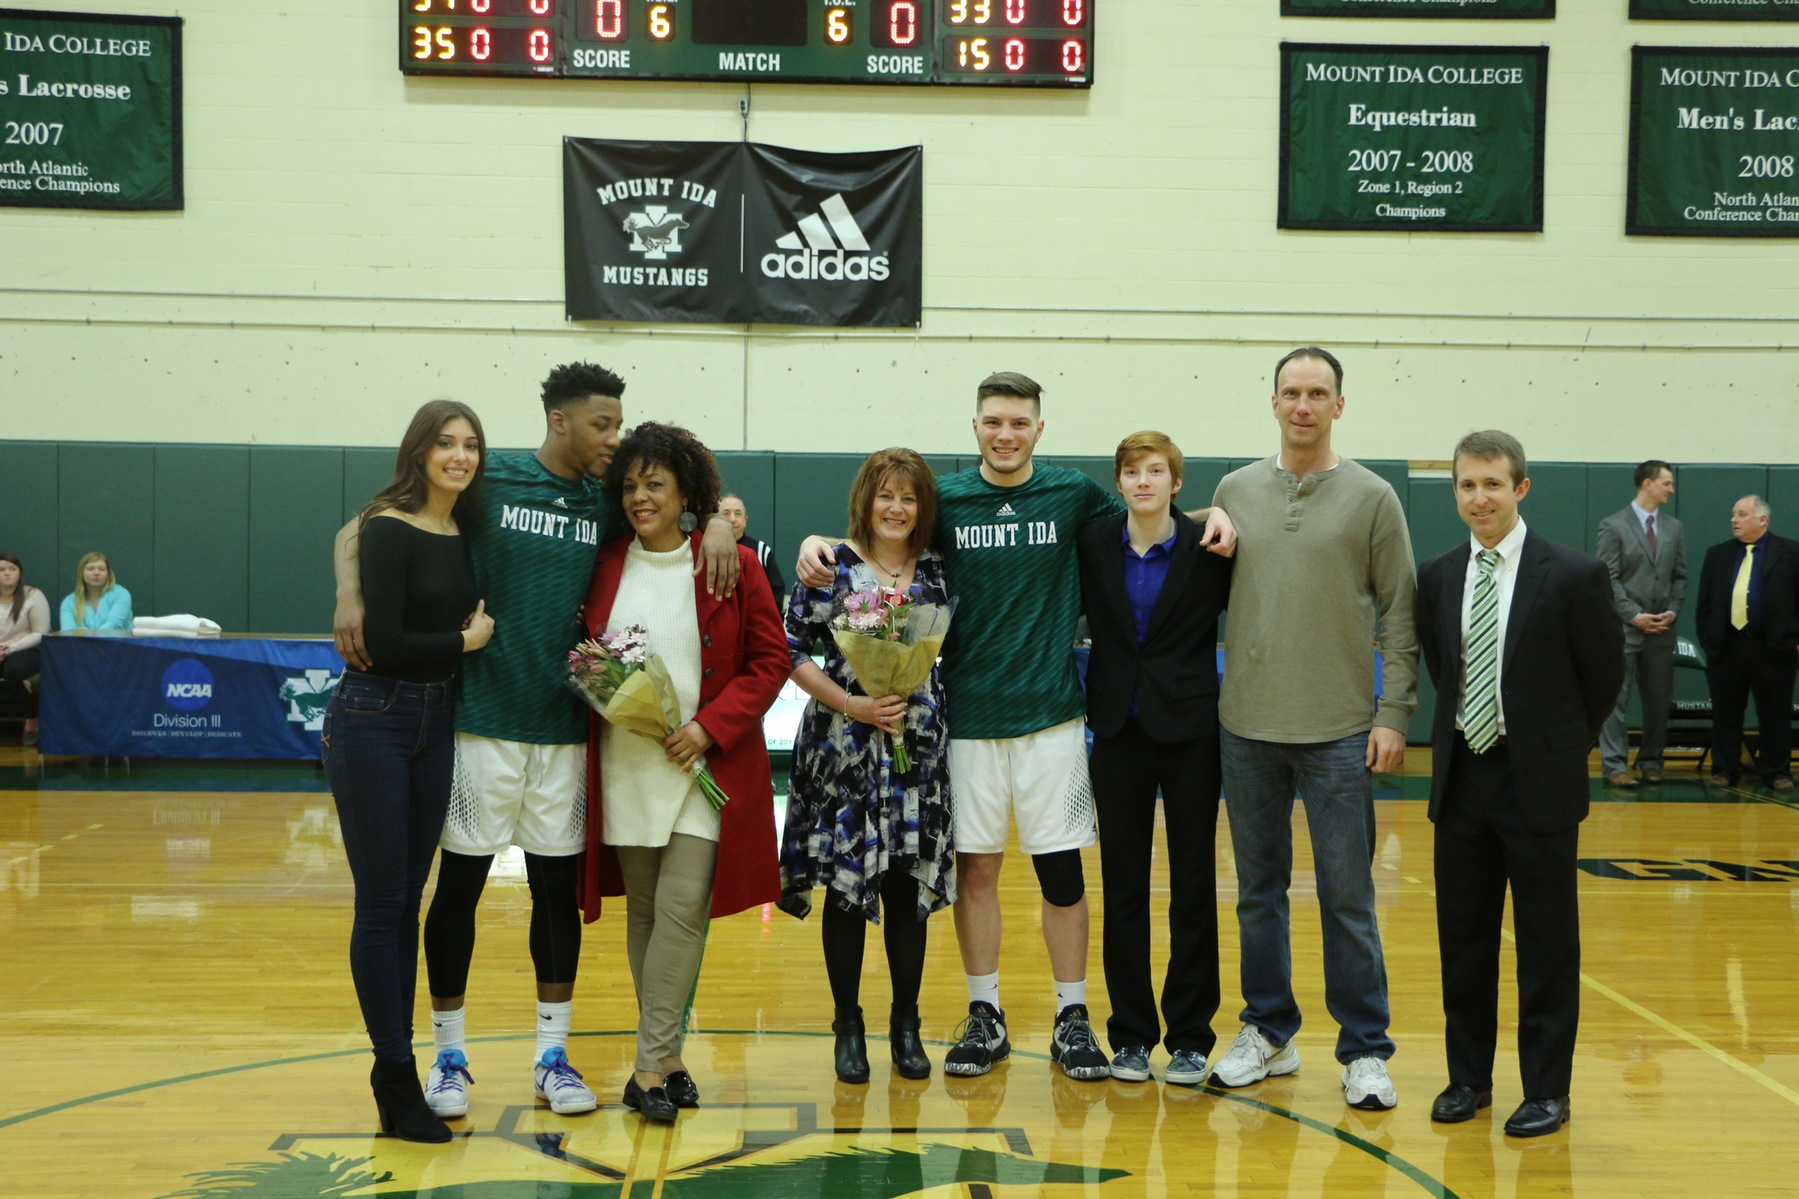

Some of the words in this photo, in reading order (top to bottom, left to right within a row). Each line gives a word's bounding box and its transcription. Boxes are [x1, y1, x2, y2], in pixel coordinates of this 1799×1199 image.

[597, 0, 621, 38] 0
[651, 6, 670, 38] 6
[828, 9, 848, 42] 6
[890, 2, 915, 44] 0
[4, 32, 45, 52] IDA
[49, 34, 152, 56] COLLEGE
[415, 26, 455, 59] 35
[472, 29, 490, 60] 0
[530, 30, 549, 61] 0
[959, 38, 990, 71] 15
[1005, 40, 1024, 70] 0
[1062, 41, 1081, 71] 0
[573, 49, 630, 68] SCORE
[719, 52, 780, 71] MATCH
[867, 55, 923, 74] SCORE
[1306, 63, 1384, 83] MOUNT
[1387, 65, 1424, 83] IDA
[1427, 66, 1523, 84] COLLEGE
[1660, 68, 1739, 87] MOUNT
[1743, 70, 1781, 88] IDA
[18, 74, 131, 100] Lacrosse
[1348, 104, 1476, 131] Equestrian
[1677, 107, 1744, 130] Men's
[1753, 109, 1799, 130] Lac
[5, 121, 64, 146] 2007
[30, 160, 89, 176] Atlantic
[1348, 150, 1401, 172] 2007
[1421, 151, 1473, 173] 2008
[1738, 155, 1794, 178] 2008
[0, 179, 32, 190] ence
[35, 176, 120, 195] Champions
[597, 178, 674, 206] MOUNT
[681, 181, 718, 208] IDA
[1358, 180, 1390, 194] Zone
[1407, 182, 1452, 197] Region
[1455, 182, 1463, 194] 2
[1713, 192, 1756, 206] North
[1760, 192, 1799, 206] Atlan
[1375, 203, 1446, 220] Champions
[1684, 206, 1762, 221] Conference
[603, 265, 709, 287] MUSTANGS
[760, 248, 890, 281] adidas
[500, 504, 569, 538] MOUNT
[575, 518, 597, 545] IDA
[955, 523, 1019, 549] MOUNT
[1027, 521, 1057, 545] IDA
[1677, 642, 1696, 658] IDA
[167, 683, 212, 698] NCAA
[1677, 702, 1712, 710] MUSTAN
[153, 713, 207, 728] Division
[211, 714, 221, 728] III
[1577, 858, 1799, 882] GN
